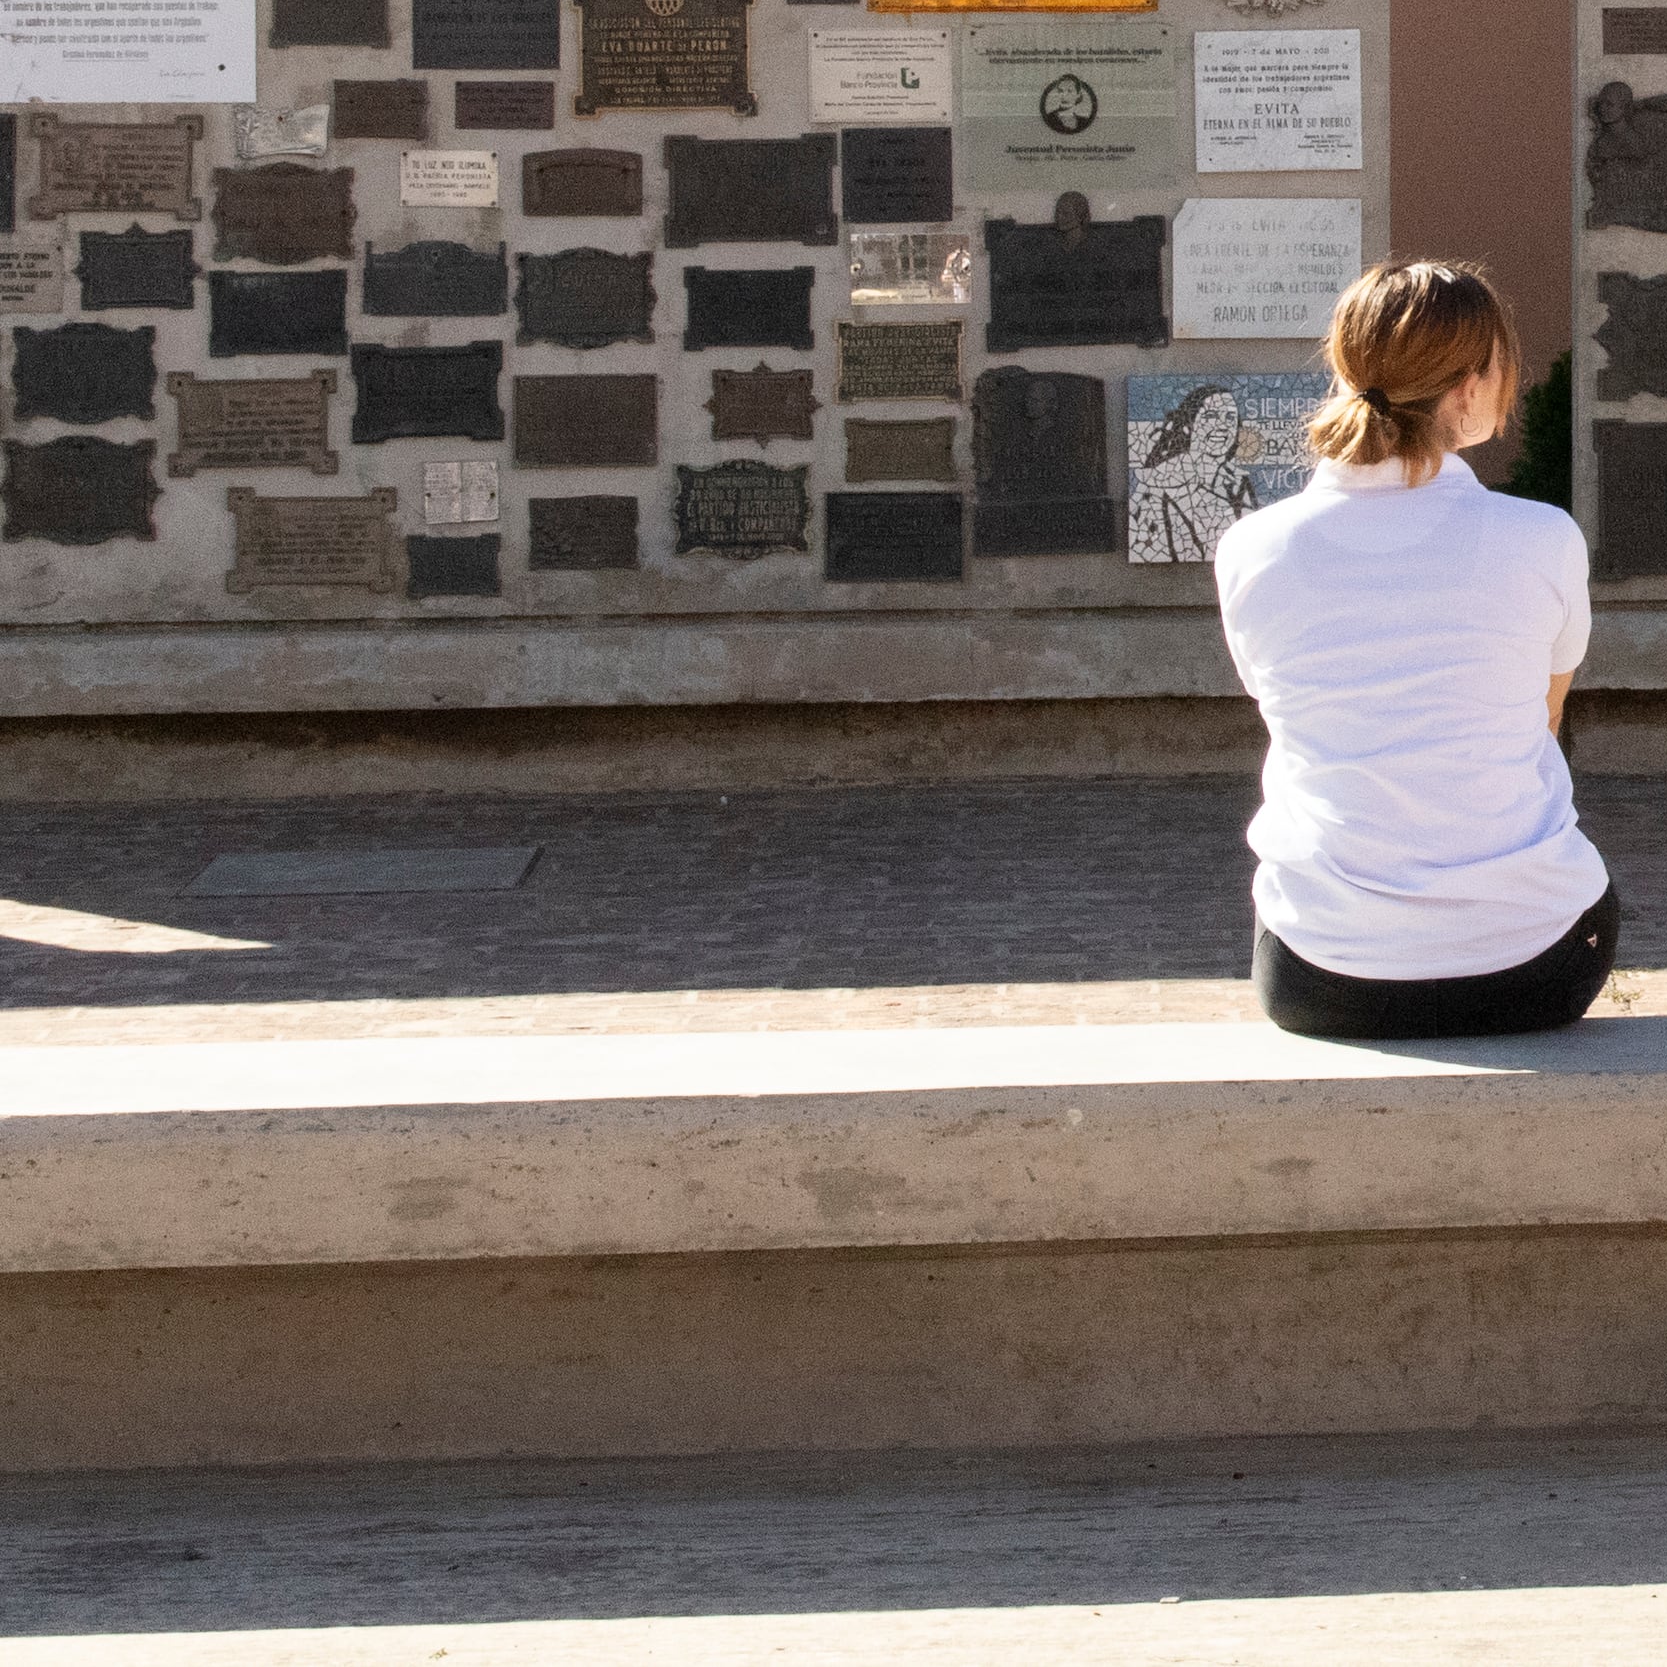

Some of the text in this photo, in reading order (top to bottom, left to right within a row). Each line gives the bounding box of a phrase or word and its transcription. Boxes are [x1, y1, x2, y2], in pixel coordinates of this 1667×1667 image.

[1254, 102, 1300, 115] EVITA
[1203, 117, 1352, 130] ETERNA EN EL ALMA DE SU PUEBLO
[1213, 305, 1257, 323] RAMON
[1244, 397, 1320, 420] SIEMPR
